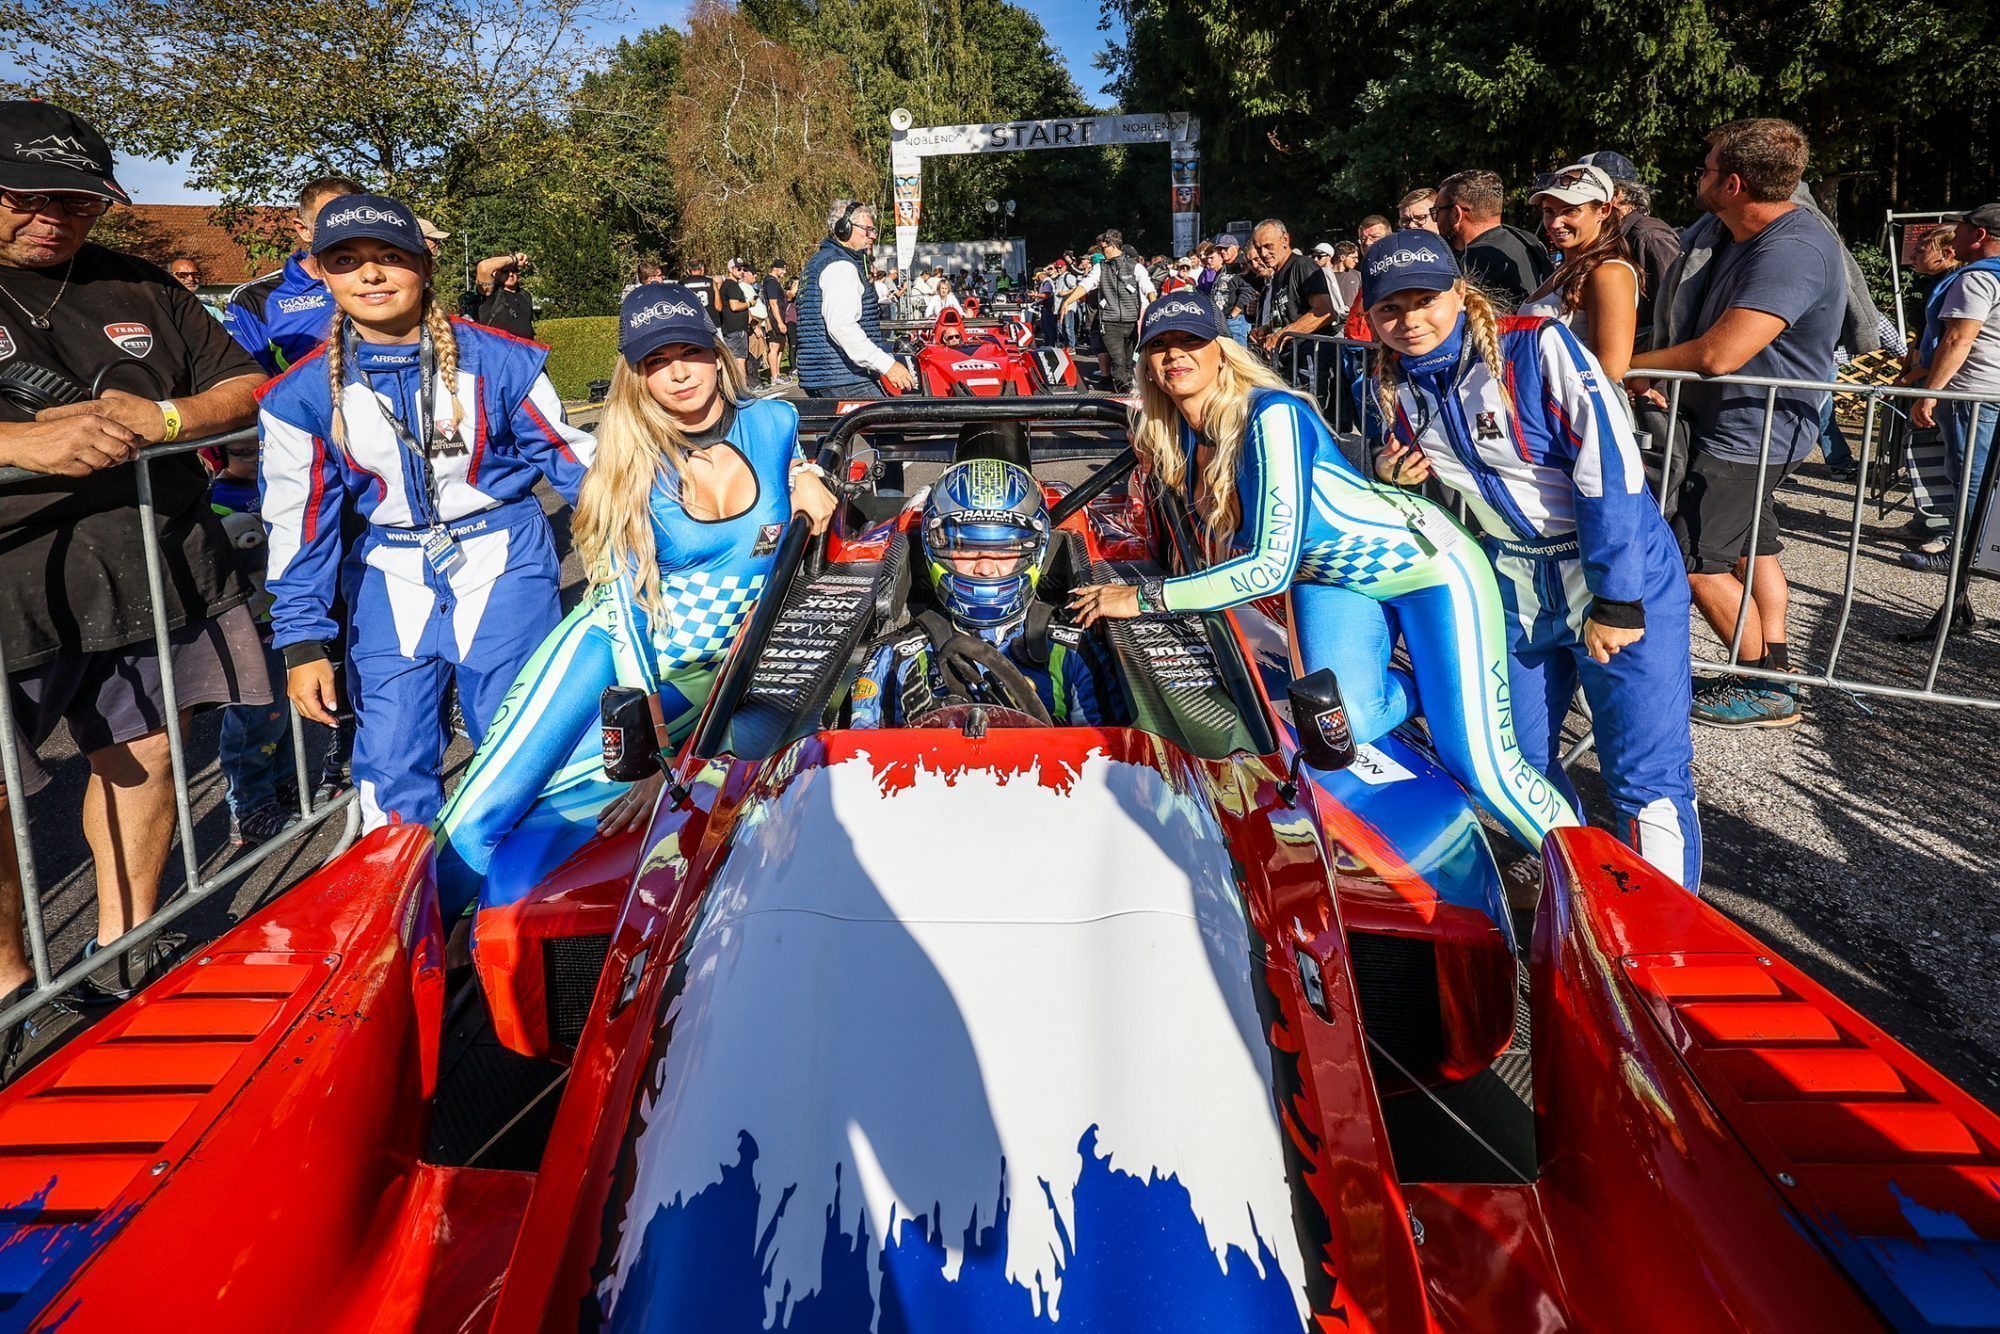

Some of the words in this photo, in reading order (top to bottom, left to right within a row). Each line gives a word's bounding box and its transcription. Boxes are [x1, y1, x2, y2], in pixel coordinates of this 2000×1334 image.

[990, 121, 1095, 149] START
[113, 326, 145, 334] TEAM
[123, 341, 149, 349] PETIT
[963, 510, 1013, 520] RAUCH
[1503, 540, 1579, 556] www.bergrenn
[799, 599, 861, 610] NGK
[1052, 630, 1079, 642] OMP
[763, 649, 831, 659] MOTU
